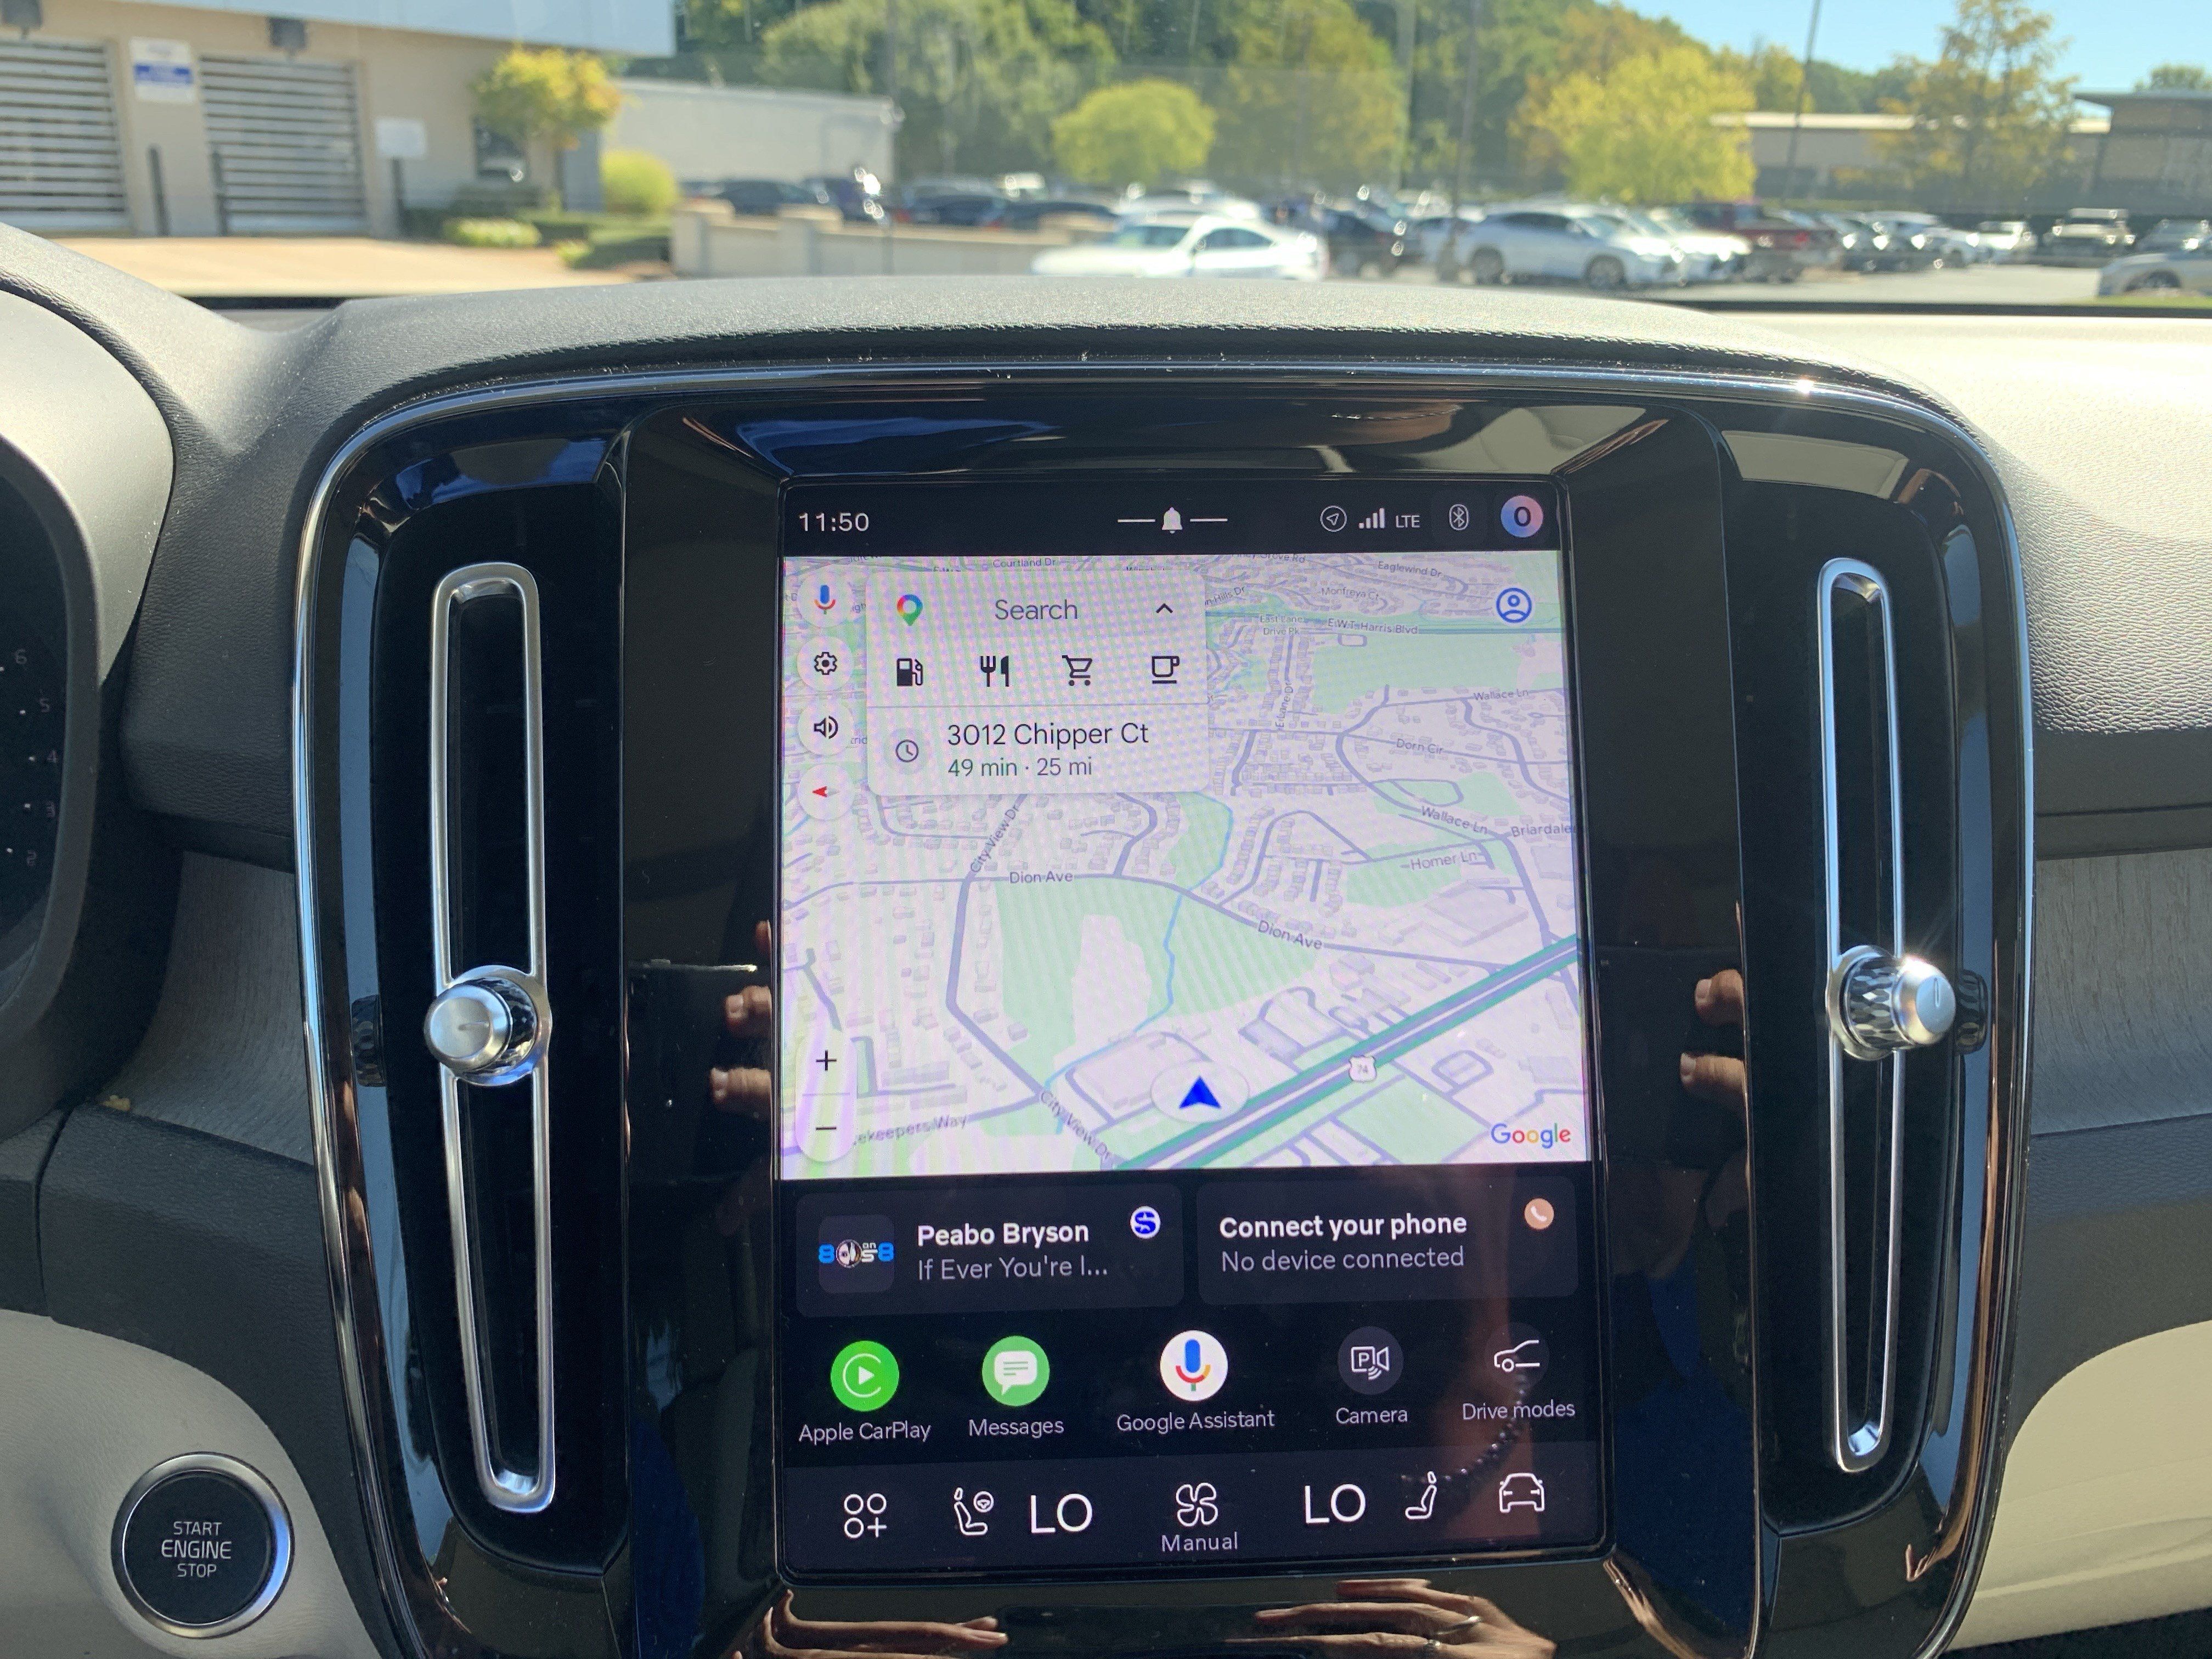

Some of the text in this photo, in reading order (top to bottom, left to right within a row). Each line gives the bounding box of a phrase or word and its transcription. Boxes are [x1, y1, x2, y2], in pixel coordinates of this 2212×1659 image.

[798, 512, 870, 532] 11:50
[1395, 515, 1421, 528] LTE
[993, 558, 1056, 568] Courtland Dr
[1378, 561, 1442, 578] Eaglewind Dr
[995, 600, 1078, 621] Search
[1360, 622, 1392, 633] Harris
[1394, 624, 1418, 635] Blvd
[15, 649, 27, 664] 6
[1472, 689, 1528, 701] Wallace Ln
[40, 698, 50, 713] 5
[947, 723, 1149, 749] 3012 Chipper Ct
[1396, 738, 1443, 754] Dorn Cir
[47, 749, 58, 763] 4
[947, 757, 1092, 776] 49 min 25 mi
[46, 800, 55, 817] 3
[1421, 805, 1488, 834] Wallace Ln
[970, 804, 1019, 872] City View Dr
[1410, 850, 1477, 870] Homer Ln
[1009, 870, 1073, 883] Dion Ave
[1258, 921, 1322, 950] Dion Ave
[1491, 1123, 1571, 1148] Google
[917, 1222, 1090, 1247] Peabo Bryson
[1220, 1213, 1467, 1241] Connect your phone
[918, 1260, 933, 1280] If
[941, 1260, 992, 1279] Ever
[999, 1257, 1071, 1278] You're
[1222, 1246, 1464, 1272] No device connected
[1336, 1408, 1408, 1424] Camera
[1463, 1400, 1575, 1421] Drive modes
[969, 1419, 1064, 1438] Messages
[1117, 1409, 1275, 1434] Google Assistant
[799, 1421, 931, 1445] Apple CarPlay
[1030, 1493, 1092, 1534] LO
[1305, 1485, 1366, 1523] LO
[173, 1521, 222, 1536] START
[161, 1539, 232, 1559] ENGINE
[1161, 1533, 1238, 1553] Manual
[178, 1564, 216, 1578] STOP
